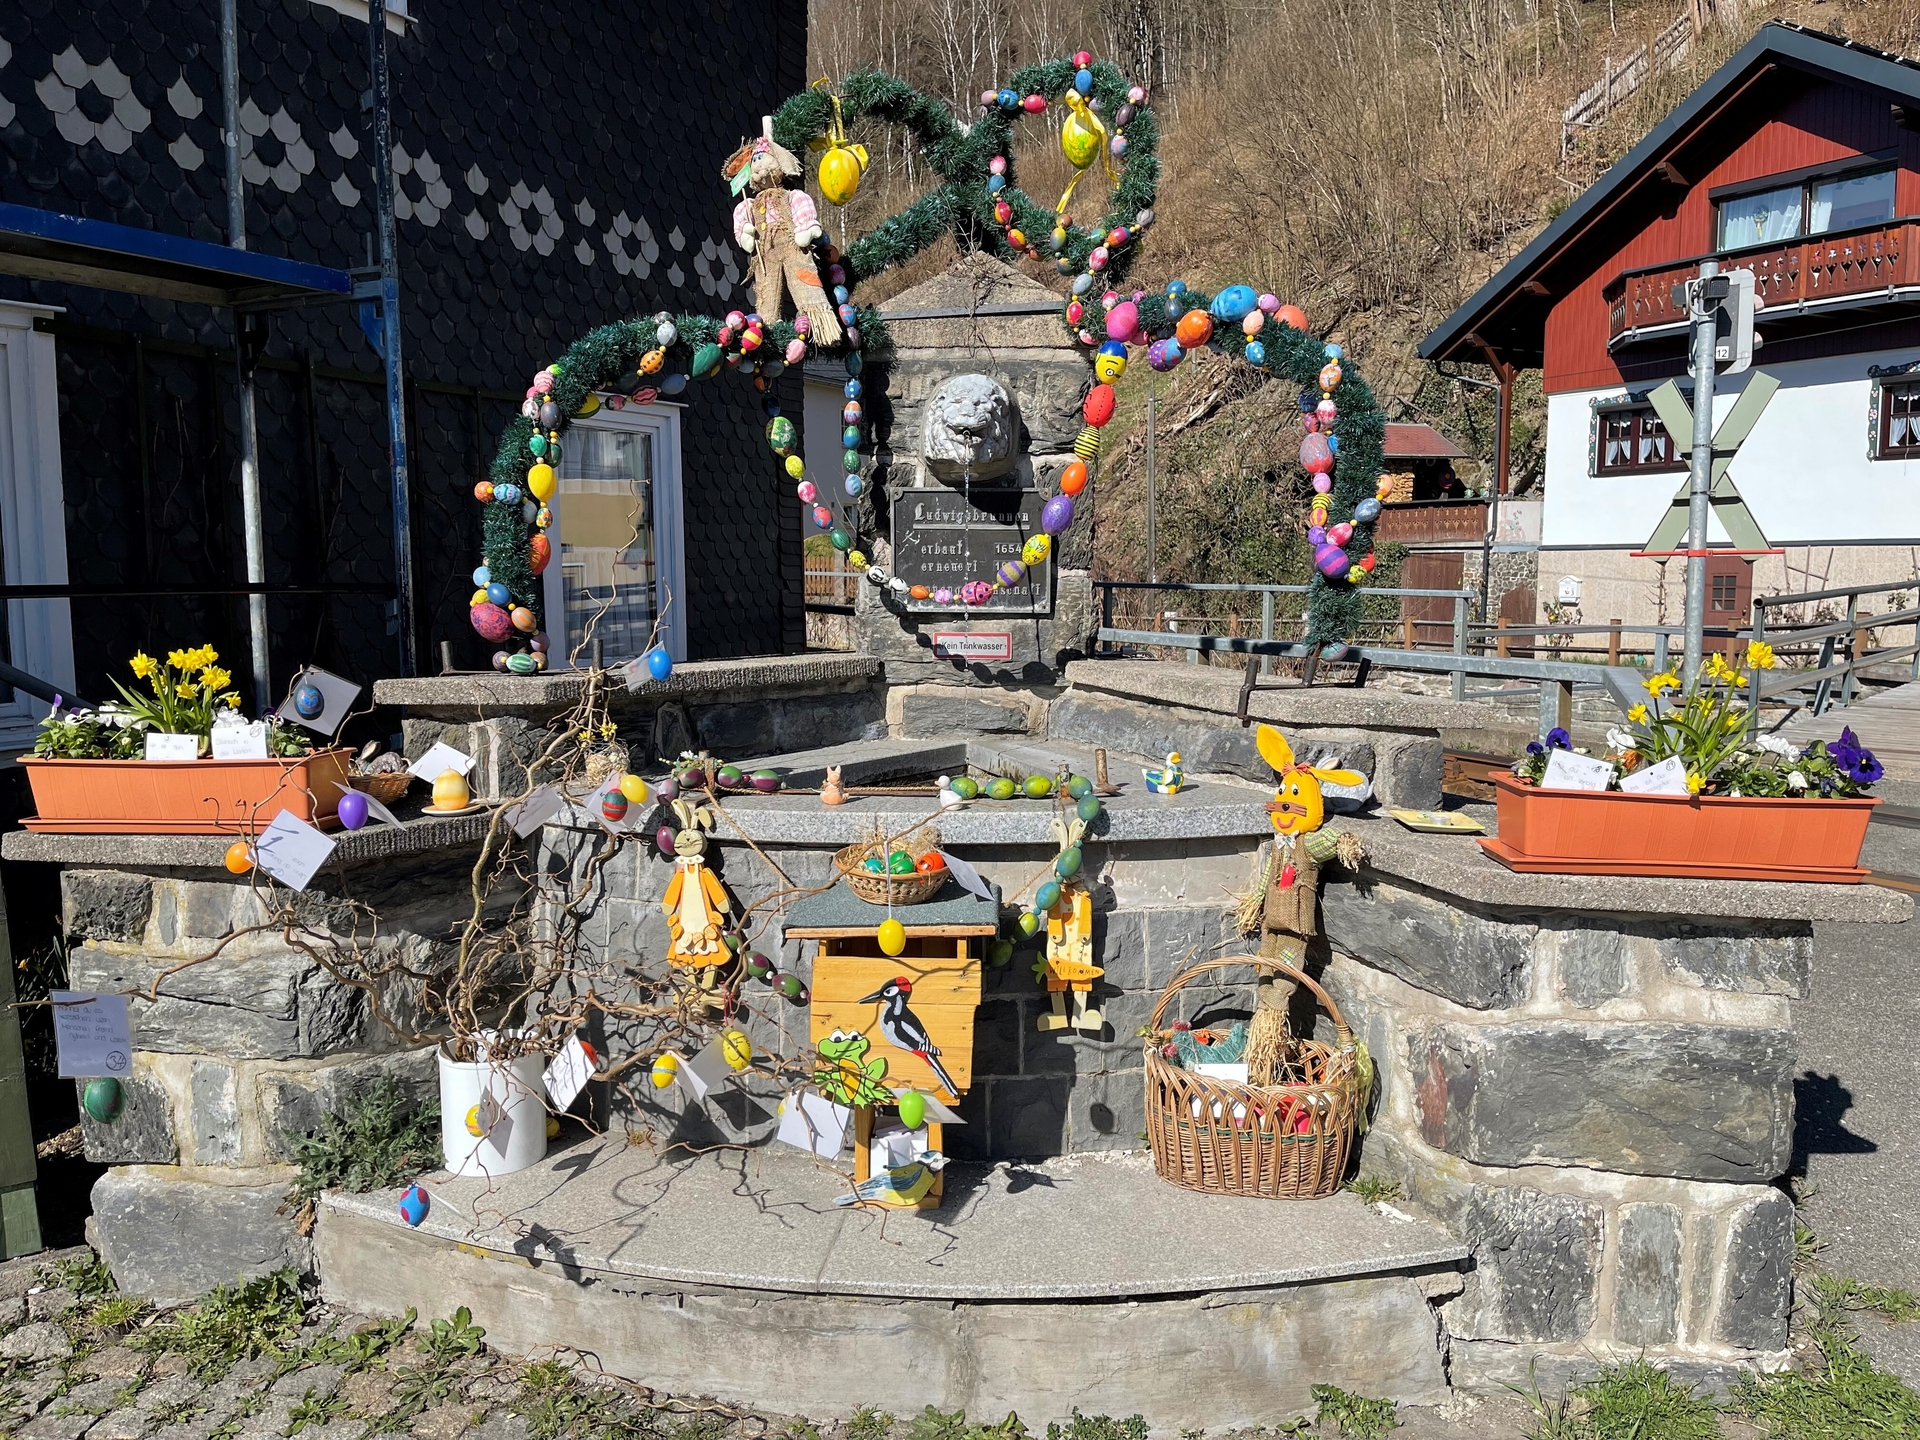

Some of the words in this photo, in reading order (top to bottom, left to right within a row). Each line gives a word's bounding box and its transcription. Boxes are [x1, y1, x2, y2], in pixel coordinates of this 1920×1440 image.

[1716, 349, 1727, 357] 12
[914, 502, 1029, 524] Ludwigsbrunnen
[921, 540, 963, 555] erbaut
[995, 544, 1022, 554] 1654
[942, 641, 958, 650] Kein
[959, 641, 1003, 650] Trinkwasser
[109, 1055, 125, 1068] 34
